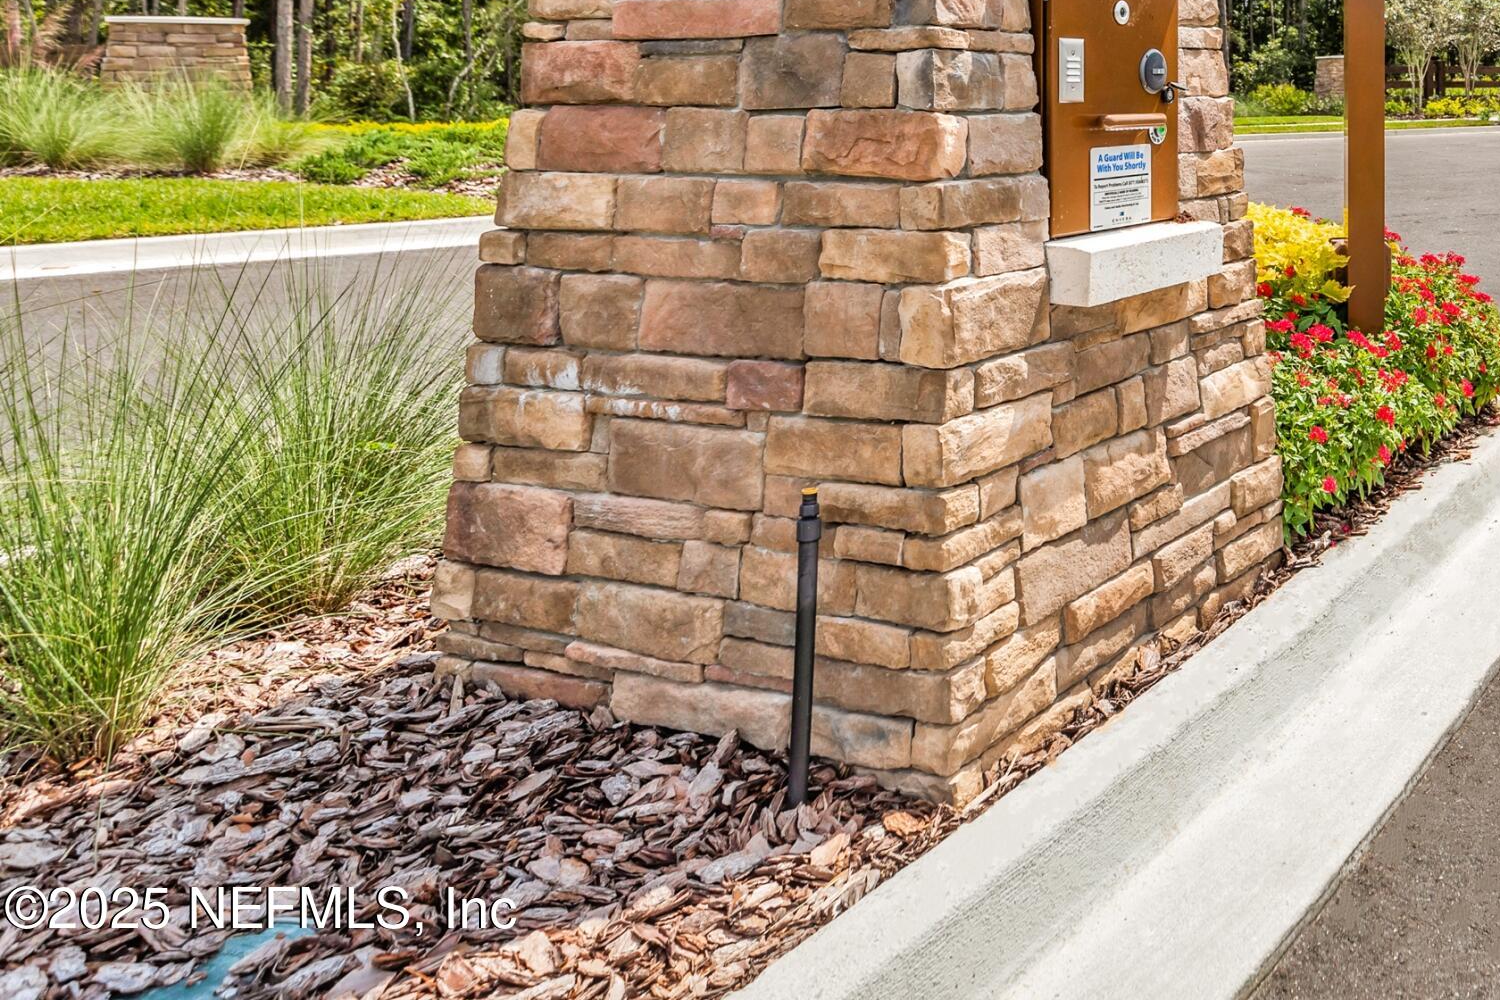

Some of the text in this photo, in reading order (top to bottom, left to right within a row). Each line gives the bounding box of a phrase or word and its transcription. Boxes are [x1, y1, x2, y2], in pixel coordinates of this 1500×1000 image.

[1098, 151, 1144, 162] A Guard Will Be
[1097, 160, 1146, 173] With You Shortly
